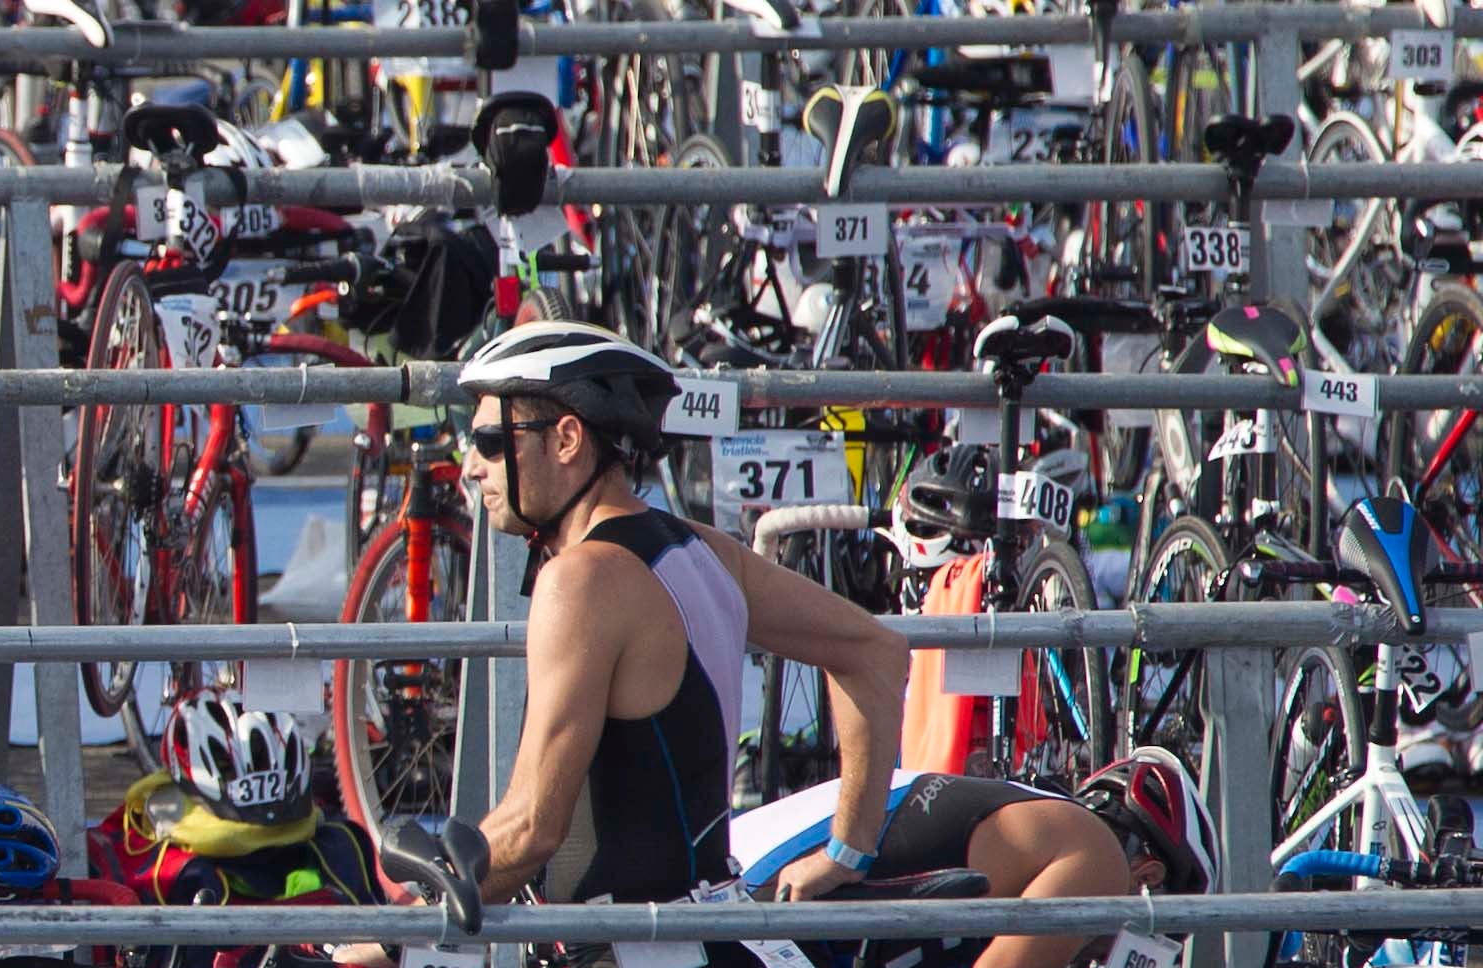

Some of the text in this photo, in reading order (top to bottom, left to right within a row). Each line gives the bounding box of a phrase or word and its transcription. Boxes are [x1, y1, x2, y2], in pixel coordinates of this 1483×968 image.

[1402, 44, 1442, 68] 303
[179, 199, 216, 259] 372
[835, 216, 868, 242] 371
[1190, 230, 1241, 268] 338
[212, 281, 277, 315] 305
[682, 391, 721, 419] 444
[1320, 379, 1358, 402] 443
[738, 459, 815, 501] 371
[1019, 479, 1069, 527] 408
[238, 772, 281, 803] 372
